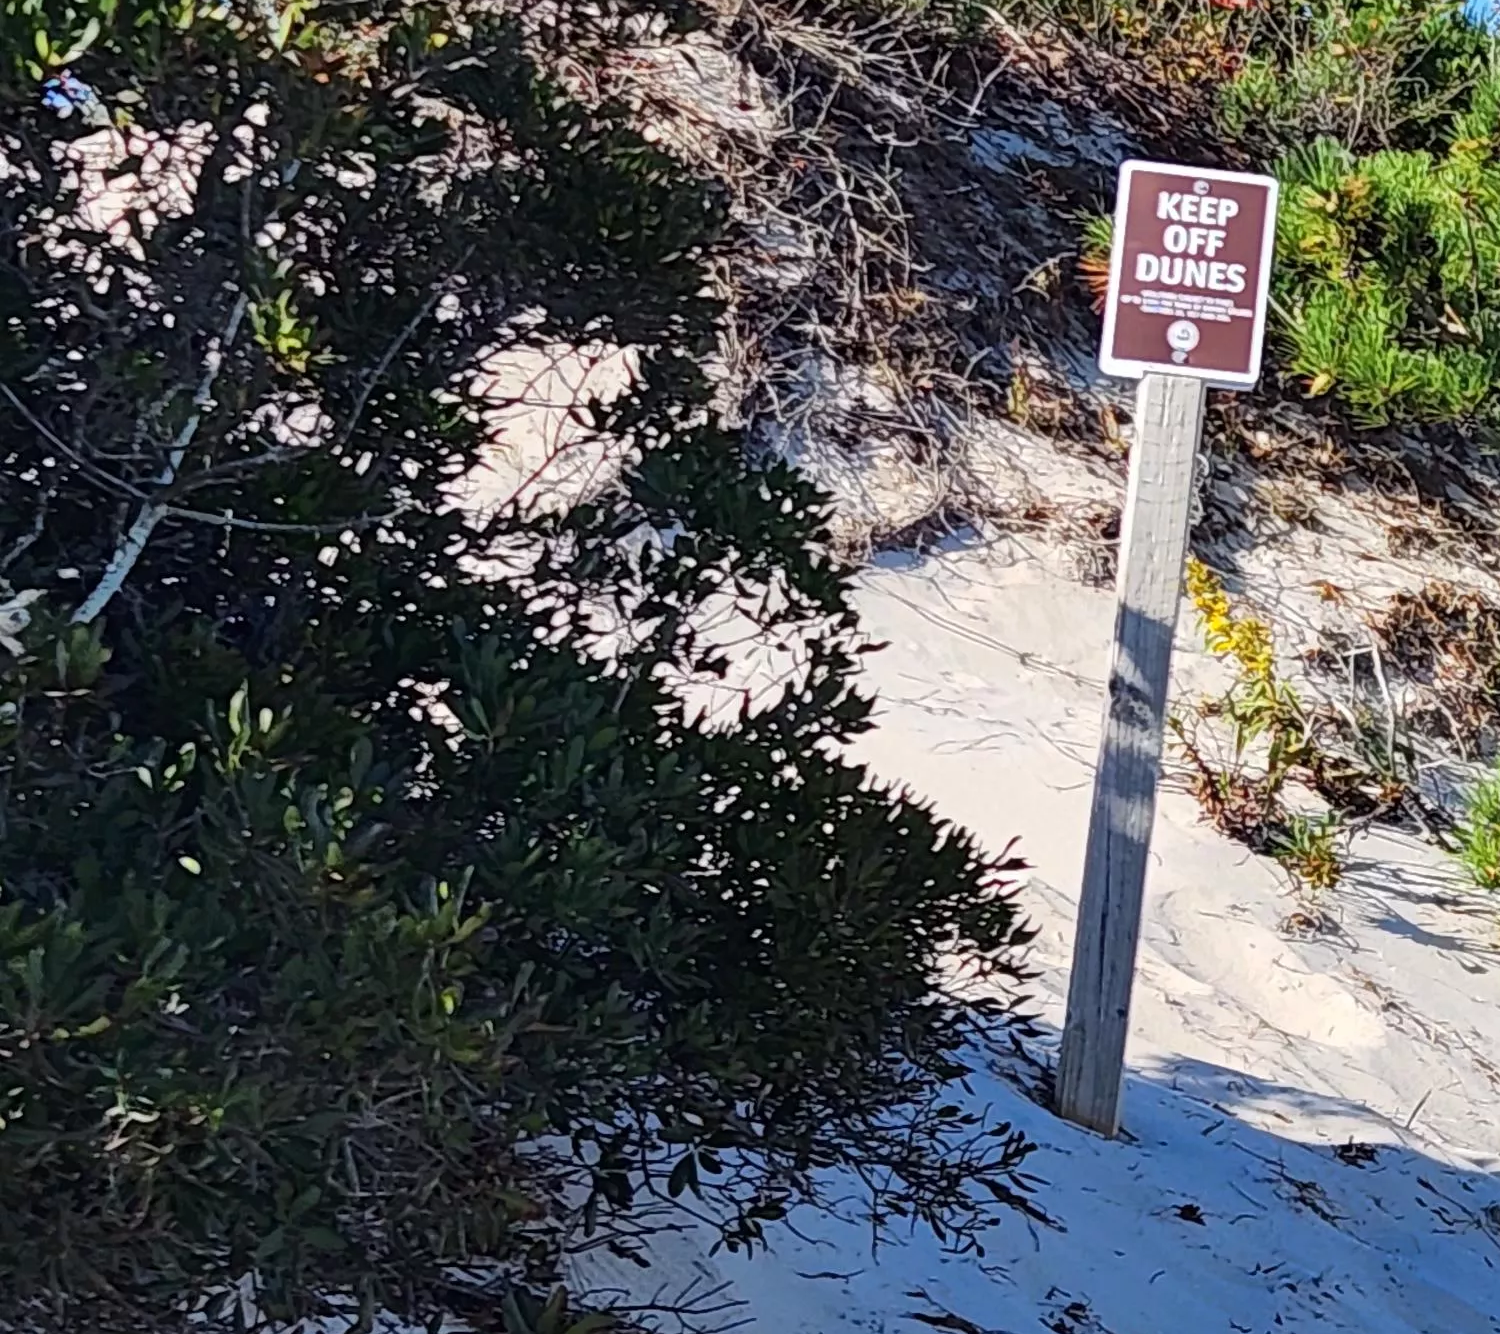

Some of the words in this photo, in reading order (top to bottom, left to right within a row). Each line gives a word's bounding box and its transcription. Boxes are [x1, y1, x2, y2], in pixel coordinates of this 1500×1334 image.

[1156, 191, 1239, 226] KEEP
[1163, 224, 1227, 258] OFF
[1135, 253, 1247, 293] DUNES
